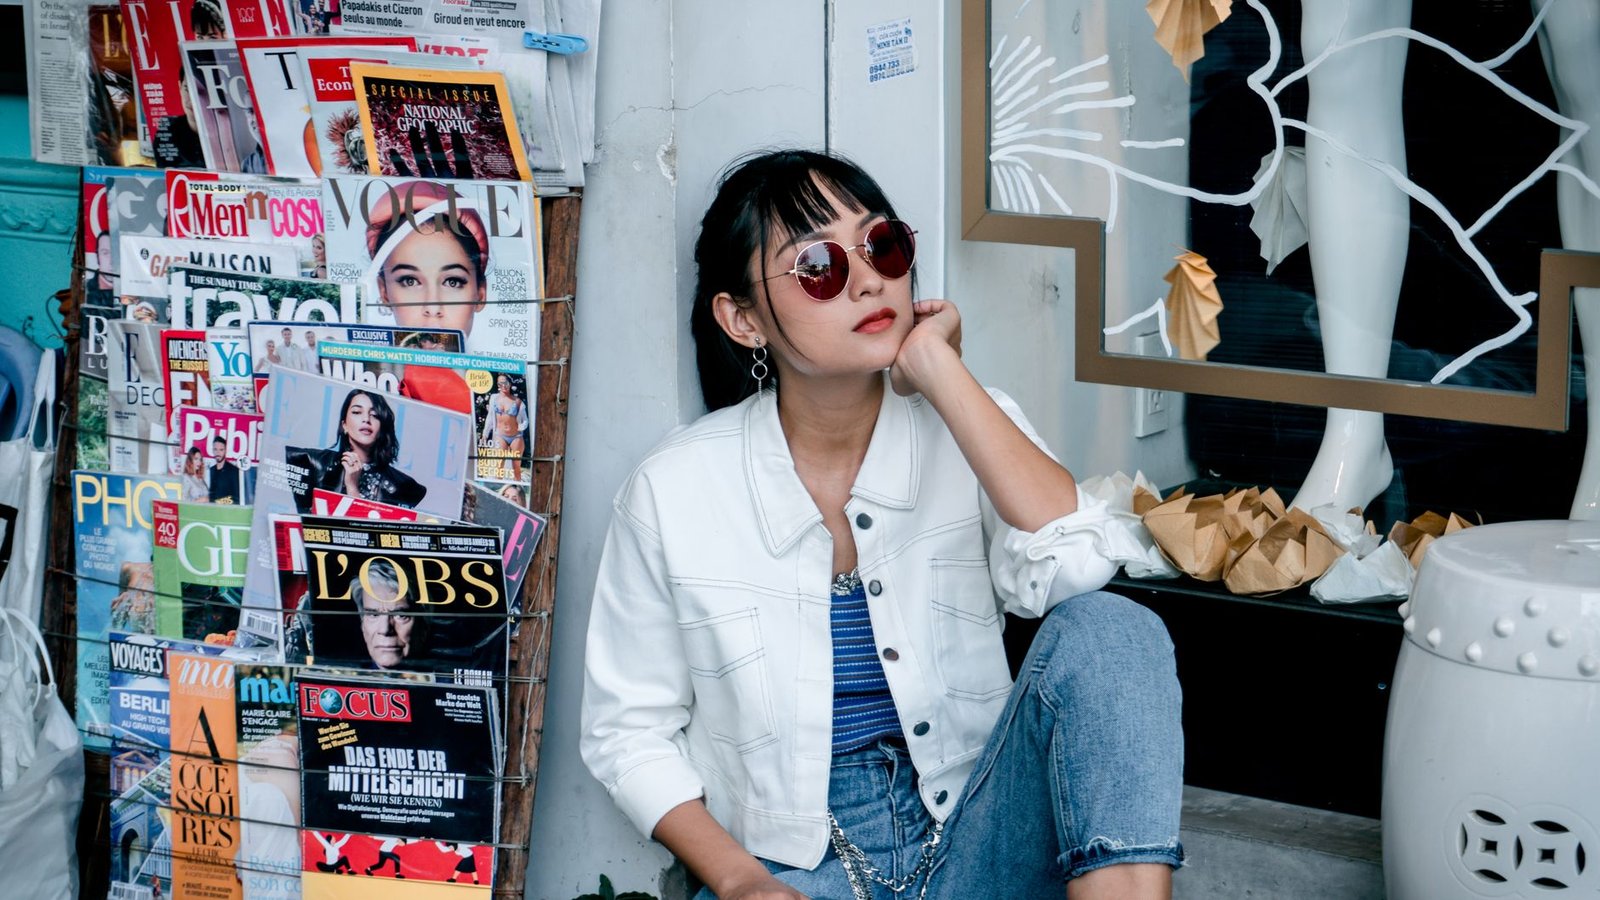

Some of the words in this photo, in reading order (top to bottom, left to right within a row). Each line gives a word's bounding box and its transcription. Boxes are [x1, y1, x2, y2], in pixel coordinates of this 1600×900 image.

[342, 0, 382, 12] Papadakis
[383, 4, 391, 12] et
[392, 4, 423, 15] Cizeron
[343, 13, 365, 24] seuls
[365, 16, 376, 25] au
[376, 17, 403, 27] monde
[434, 13, 462, 25] Giroud
[463, 16, 474, 26] en
[475, 17, 495, 27] veut
[496, 19, 526, 29] encore
[371, 83, 434, 100] SPECIAL
[444, 89, 491, 102] ISSUE
[403, 104, 466, 120] NATIONAL
[189, 183, 241, 192] TOTAL-BODY
[324, 178, 523, 237] VOGUE
[330, 268, 362, 277] NAOMI
[189, 274, 205, 285] THE
[205, 275, 238, 289] SUNDAY
[238, 280, 263, 291] TIMES
[496, 276, 526, 285] DOLLAR
[492, 284, 526, 292] FASHION
[488, 319, 528, 329] SPRING'S
[352, 330, 388, 341] EXCLUSIVE
[508, 329, 528, 338] BEST
[503, 337, 528, 348] BAGS
[321, 346, 362, 358] MURDERER
[363, 348, 385, 359] CHRIS
[414, 354, 452, 366] HORRIFIC
[452, 357, 470, 367] NEW
[471, 358, 520, 372] CONFESSION
[478, 467, 515, 479] SECRETS
[157, 522, 176, 537] 40
[159, 536, 176, 545] ANS
[312, 550, 499, 609] L'OBS
[110, 642, 164, 674] VOYAGES
[303, 686, 409, 719] FOCUS
[435, 699, 455, 708] Marke
[455, 700, 466, 708] der
[467, 701, 481, 709] Welt
[446, 692, 456, 700] Die
[456, 693, 480, 702] coolste
[130, 712, 147, 722] HIGH
[148, 714, 167, 726] TECH
[242, 709, 265, 717] MARIE
[266, 710, 291, 718] CLAIRE
[121, 720, 132, 728] AU
[132, 721, 156, 732] GRAND
[242, 717, 279, 726] S'ENGAGE
[343, 746, 376, 767] DAS
[378, 747, 415, 770] ENDE
[417, 749, 447, 772] DER
[328, 765, 466, 799] MITTELSCHICHT
[350, 793, 370, 803] (WIE
[371, 794, 388, 805] WIR
[389, 796, 402, 805] SIE
[403, 797, 443, 808] KENNEN)
